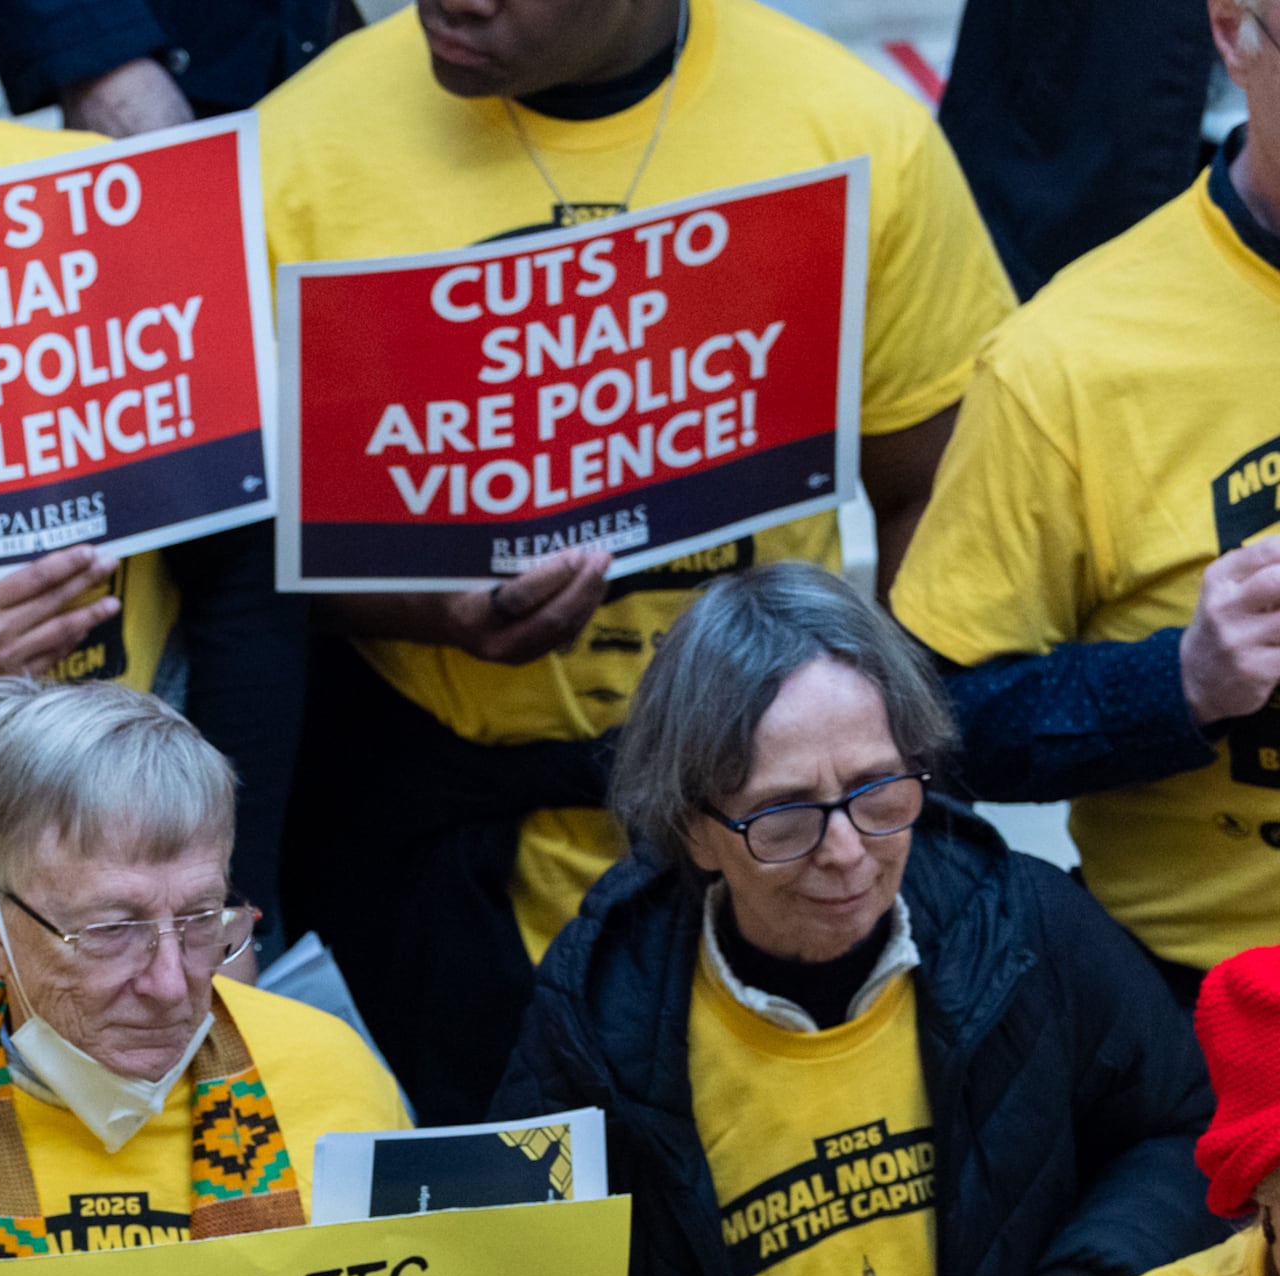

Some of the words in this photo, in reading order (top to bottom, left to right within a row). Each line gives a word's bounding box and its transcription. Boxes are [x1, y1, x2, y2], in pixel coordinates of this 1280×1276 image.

[56, 163, 141, 237] TO
[430, 237, 617, 323] CUTS
[635, 211, 728, 279] TO
[478, 290, 668, 384] SNAP
[366, 394, 513, 455] ARE
[539, 321, 785, 440] POLICY
[389, 391, 757, 515] VIOLENCE!
[492, 504, 649, 557] REPAIRERS
[824, 1125, 883, 1159] 2026
[80, 1196, 142, 1217] 2026
[721, 1173, 835, 1246] MORAL
[760, 1223, 789, 1259] AT
[792, 1199, 849, 1242] THE
